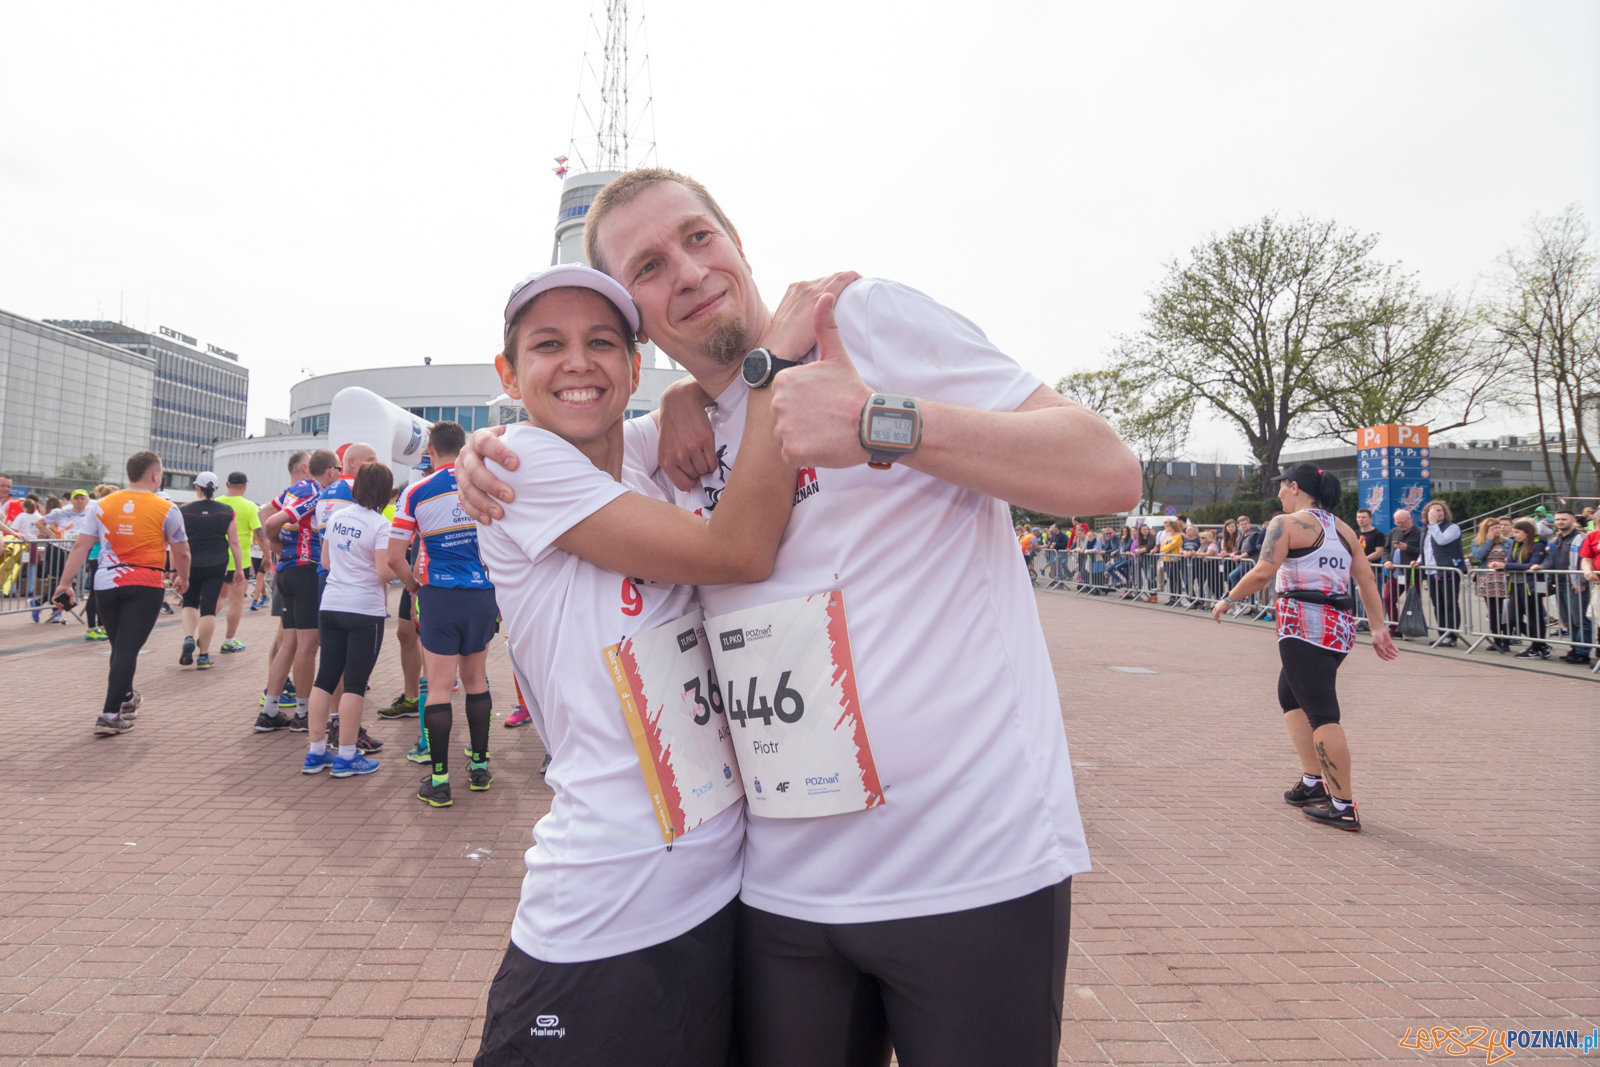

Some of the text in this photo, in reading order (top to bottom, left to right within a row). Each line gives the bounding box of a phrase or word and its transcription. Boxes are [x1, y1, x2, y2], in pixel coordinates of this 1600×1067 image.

[1364, 428, 1381, 447] P4
[1398, 426, 1420, 445] P4
[1394, 448, 1417, 457] P1 P2
[1394, 458, 1405, 467] P3
[1394, 469, 1405, 477] P5
[332, 521, 362, 539] Marta
[1318, 556, 1346, 570] POL
[728, 670, 805, 729] 446
[753, 740, 779, 755] Piotr
[775, 781, 790, 793] 4F
[530, 1027, 566, 1039] Kalenji
